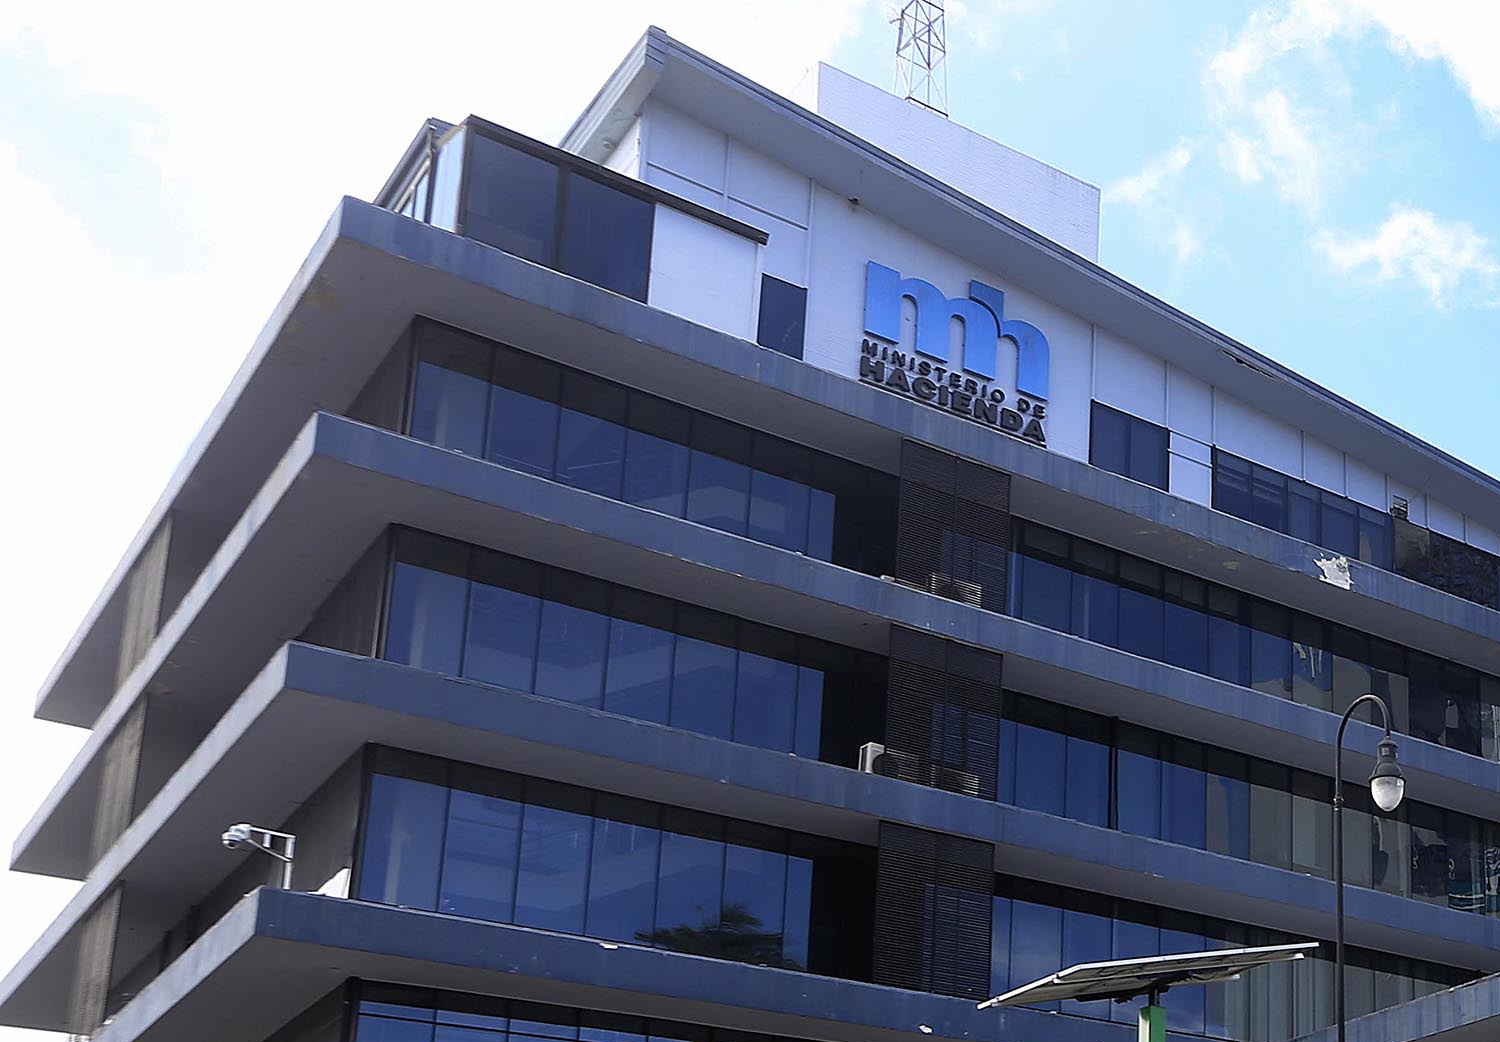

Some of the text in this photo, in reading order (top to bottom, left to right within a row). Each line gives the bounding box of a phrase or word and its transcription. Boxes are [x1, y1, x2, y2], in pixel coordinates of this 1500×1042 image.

[860, 355, 1046, 442] HACIENDA
[861, 338, 1046, 420] MINISTERIO DE
